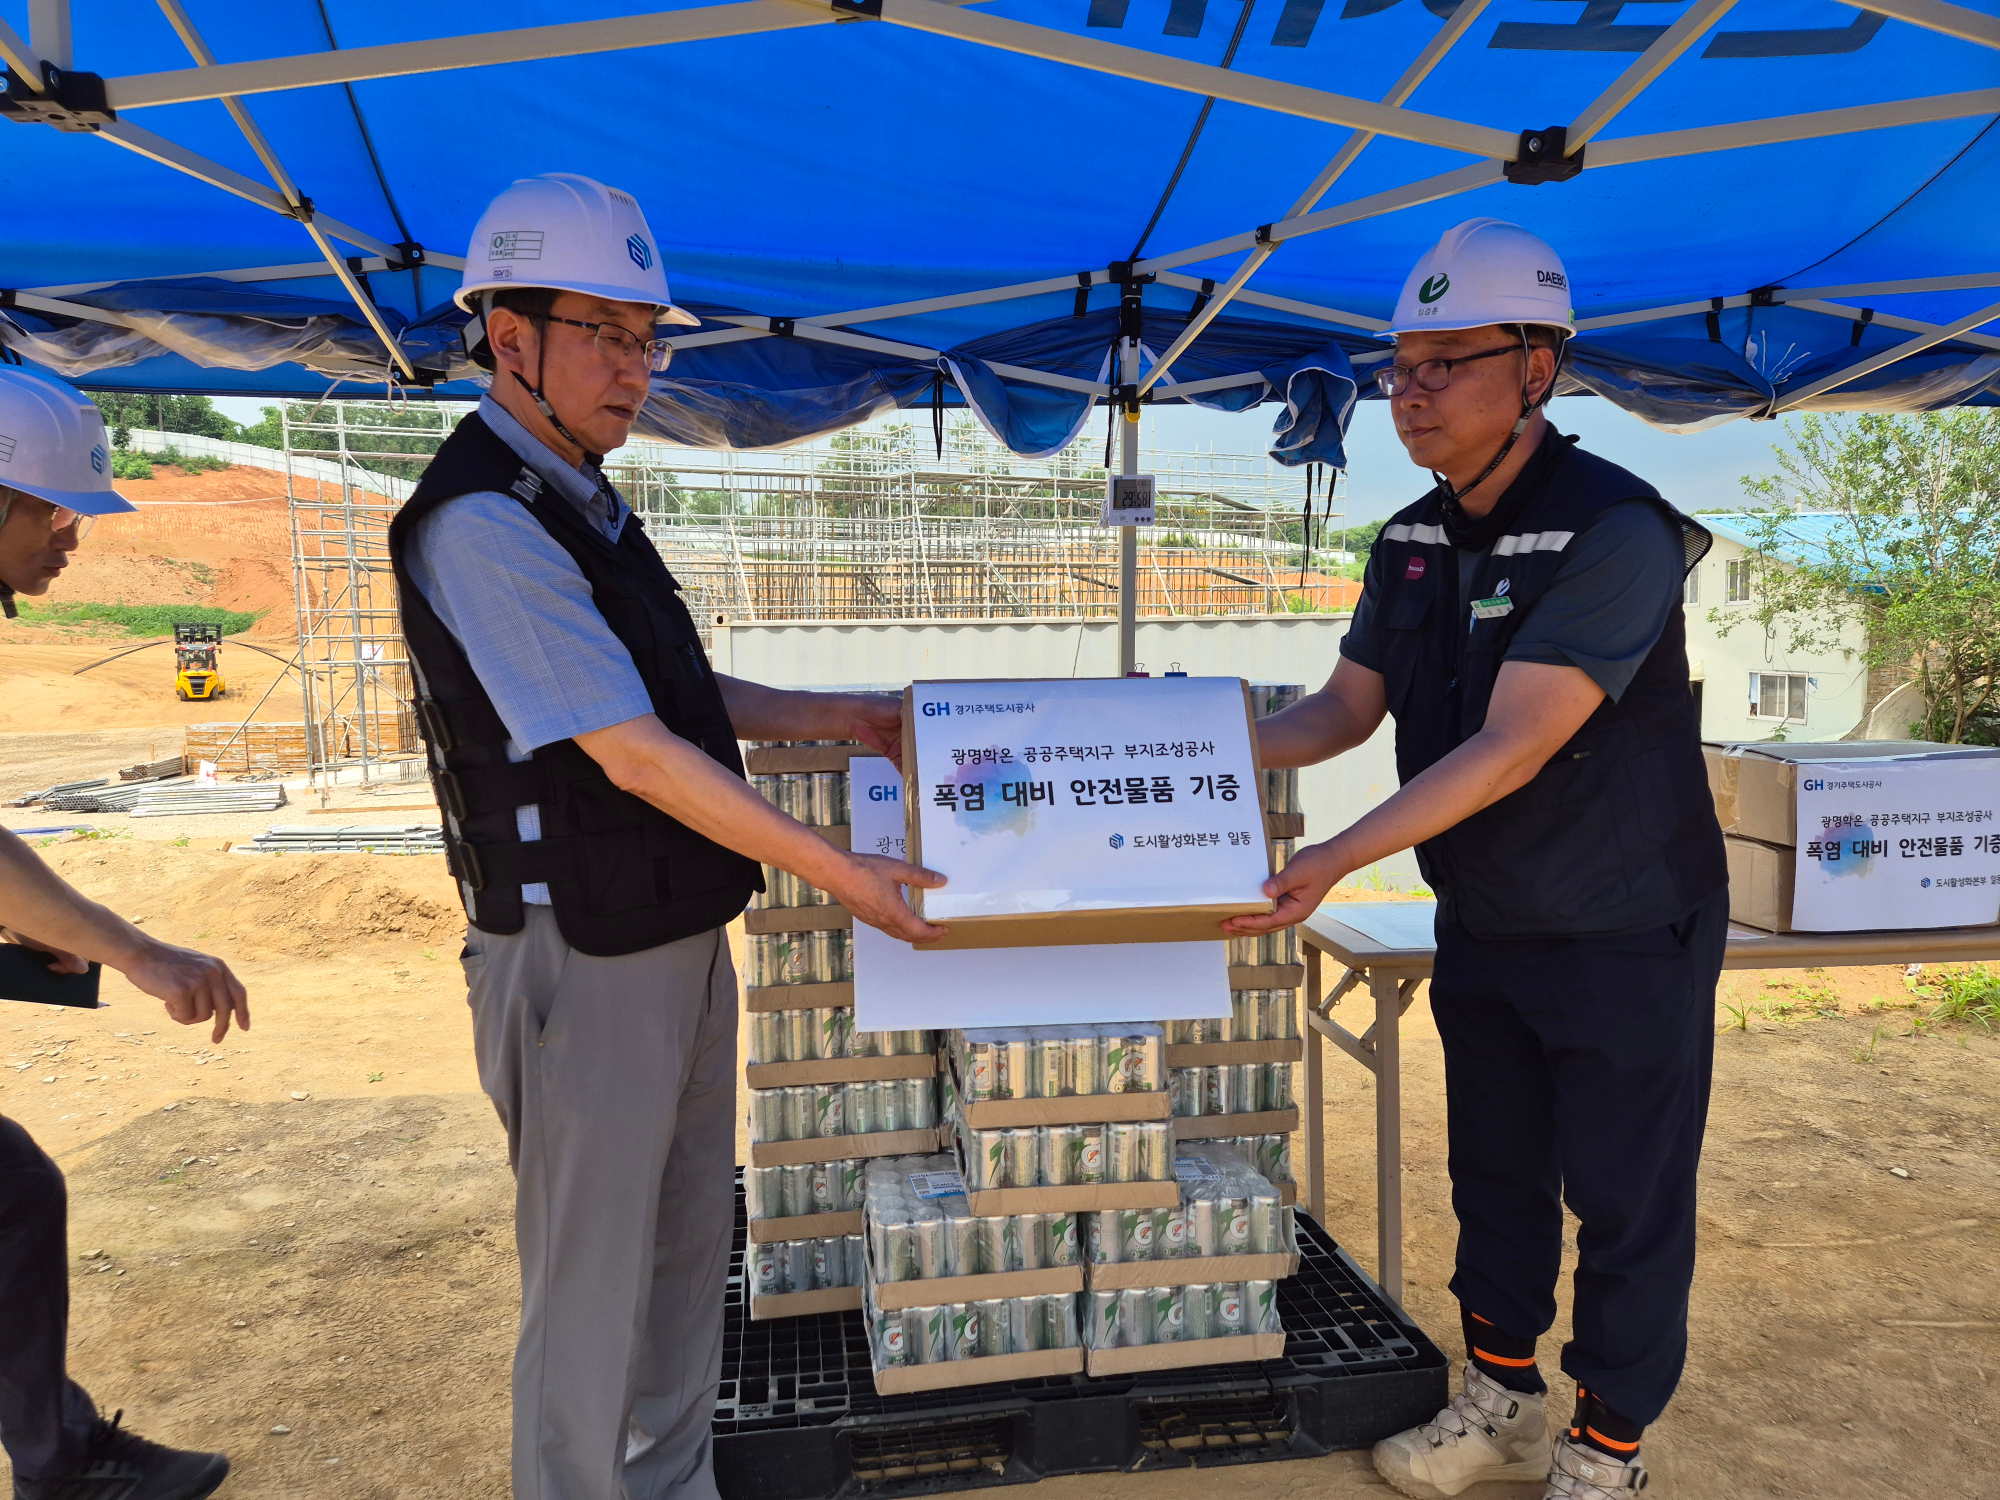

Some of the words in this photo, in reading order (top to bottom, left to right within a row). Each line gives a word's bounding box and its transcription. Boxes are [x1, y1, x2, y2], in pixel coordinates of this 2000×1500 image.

[922, 702, 951, 717] GH
[955, 703, 1035, 715] 경기주택도시공사
[951, 747, 1014, 765] 광명학온
[1023, 745, 1115, 763] 공공주택지구
[1124, 740, 1215, 759] 부지조성공사
[869, 785, 898, 802] GH
[933, 782, 985, 812] 폭염
[1001, 781, 1055, 807] 대비
[1070, 775, 1175, 806] 안전물품
[1189, 773, 1241, 802] 기증
[1803, 779, 1824, 791] GH
[1826, 780, 1882, 791] 경기주택도시공사
[1821, 814, 1863, 828] 광명학온
[1870, 812, 1931, 827] 공공주택지구
[1936, 809, 1993, 823] 부지조성공사
[1133, 832, 1221, 849] 도시활성화본부
[1227, 831, 1252, 847] 일동
[1806, 840, 1841, 861] 폭염
[1852, 839, 1888, 858] 대비
[1899, 835, 1964, 858] 안전물품
[1935, 876, 1987, 888] 도시활성화본부
[969, 1060, 989, 1084] G
[1081, 1144, 1101, 1168] G
[1134, 1220, 1153, 1245] G
[1165, 1218, 1184, 1242] G
[1230, 1215, 1248, 1239] G
[1220, 1298, 1240, 1322] G
[883, 1325, 903, 1351] G
